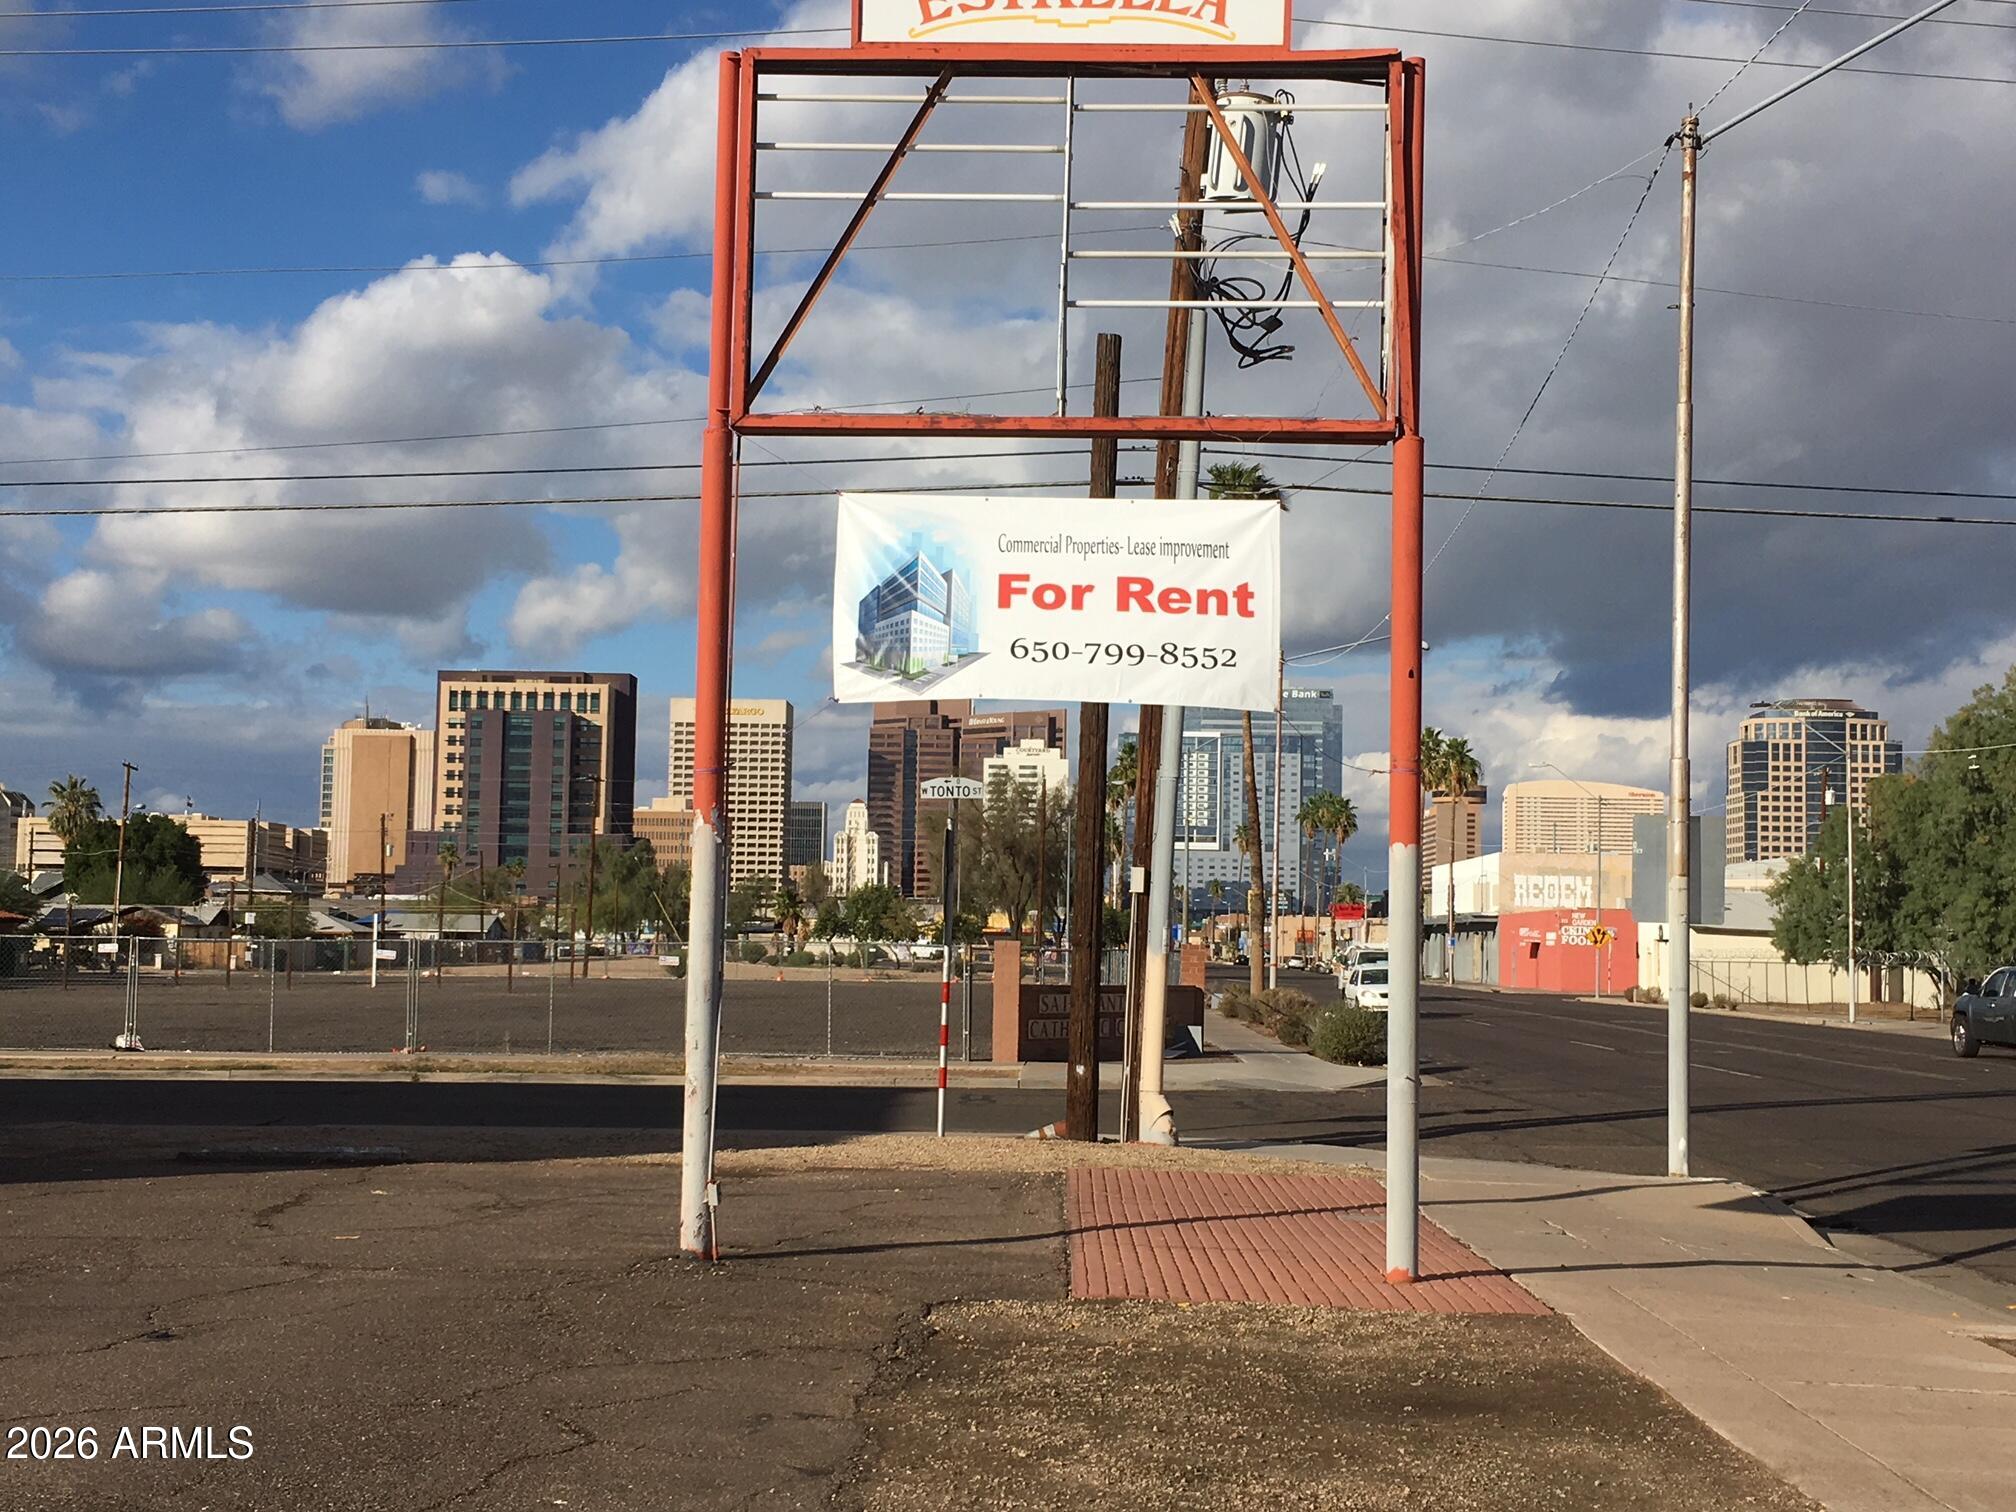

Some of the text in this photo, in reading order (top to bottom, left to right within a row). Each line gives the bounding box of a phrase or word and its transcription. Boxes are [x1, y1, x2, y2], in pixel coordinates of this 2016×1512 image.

[998, 533, 1062, 555] Commercial
[1127, 536, 1157, 556] Lease
[1159, 537, 1230, 564] improvement
[997, 573, 1255, 618] For Rent
[1010, 637, 1237, 670] 650-799-8552
[1291, 690, 1317, 699] Bank
[921, 785, 982, 797] W TONTO ST
